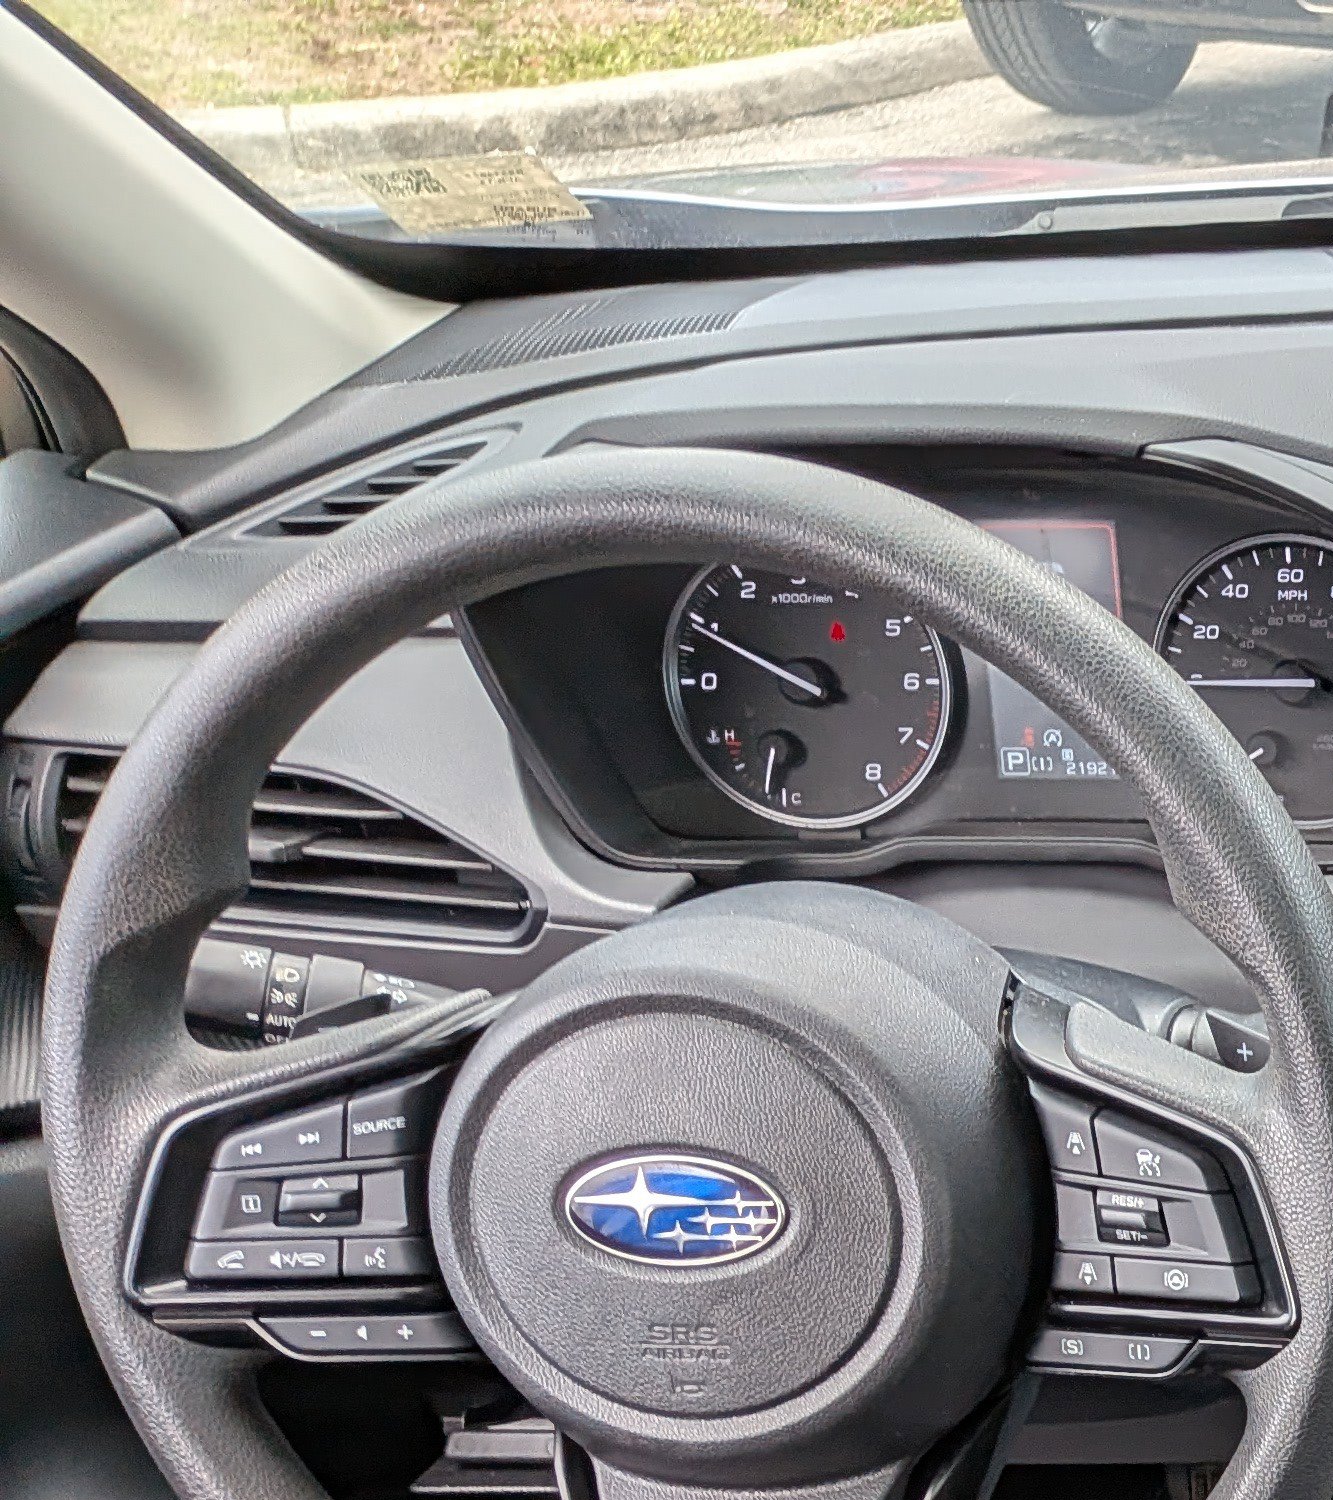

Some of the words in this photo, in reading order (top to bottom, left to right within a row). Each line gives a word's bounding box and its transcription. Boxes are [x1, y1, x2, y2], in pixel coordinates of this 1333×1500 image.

[1277, 569, 1304, 583] 60
[740, 581, 756, 599] 2
[1221, 584, 1249, 599] 40
[1277, 590, 1308, 601] MPH
[885, 619, 901, 637] 5
[1193, 625, 1220, 640] 20
[701, 672, 718, 691] 0
[903, 673, 920, 690] 6
[724, 729, 735, 740] H
[897, 727, 914, 744] 7
[865, 763, 882, 782] 8
[791, 794, 802, 805] C
[352, 1115, 406, 1136] SOURCE
[648, 1324, 719, 1345] SRS
